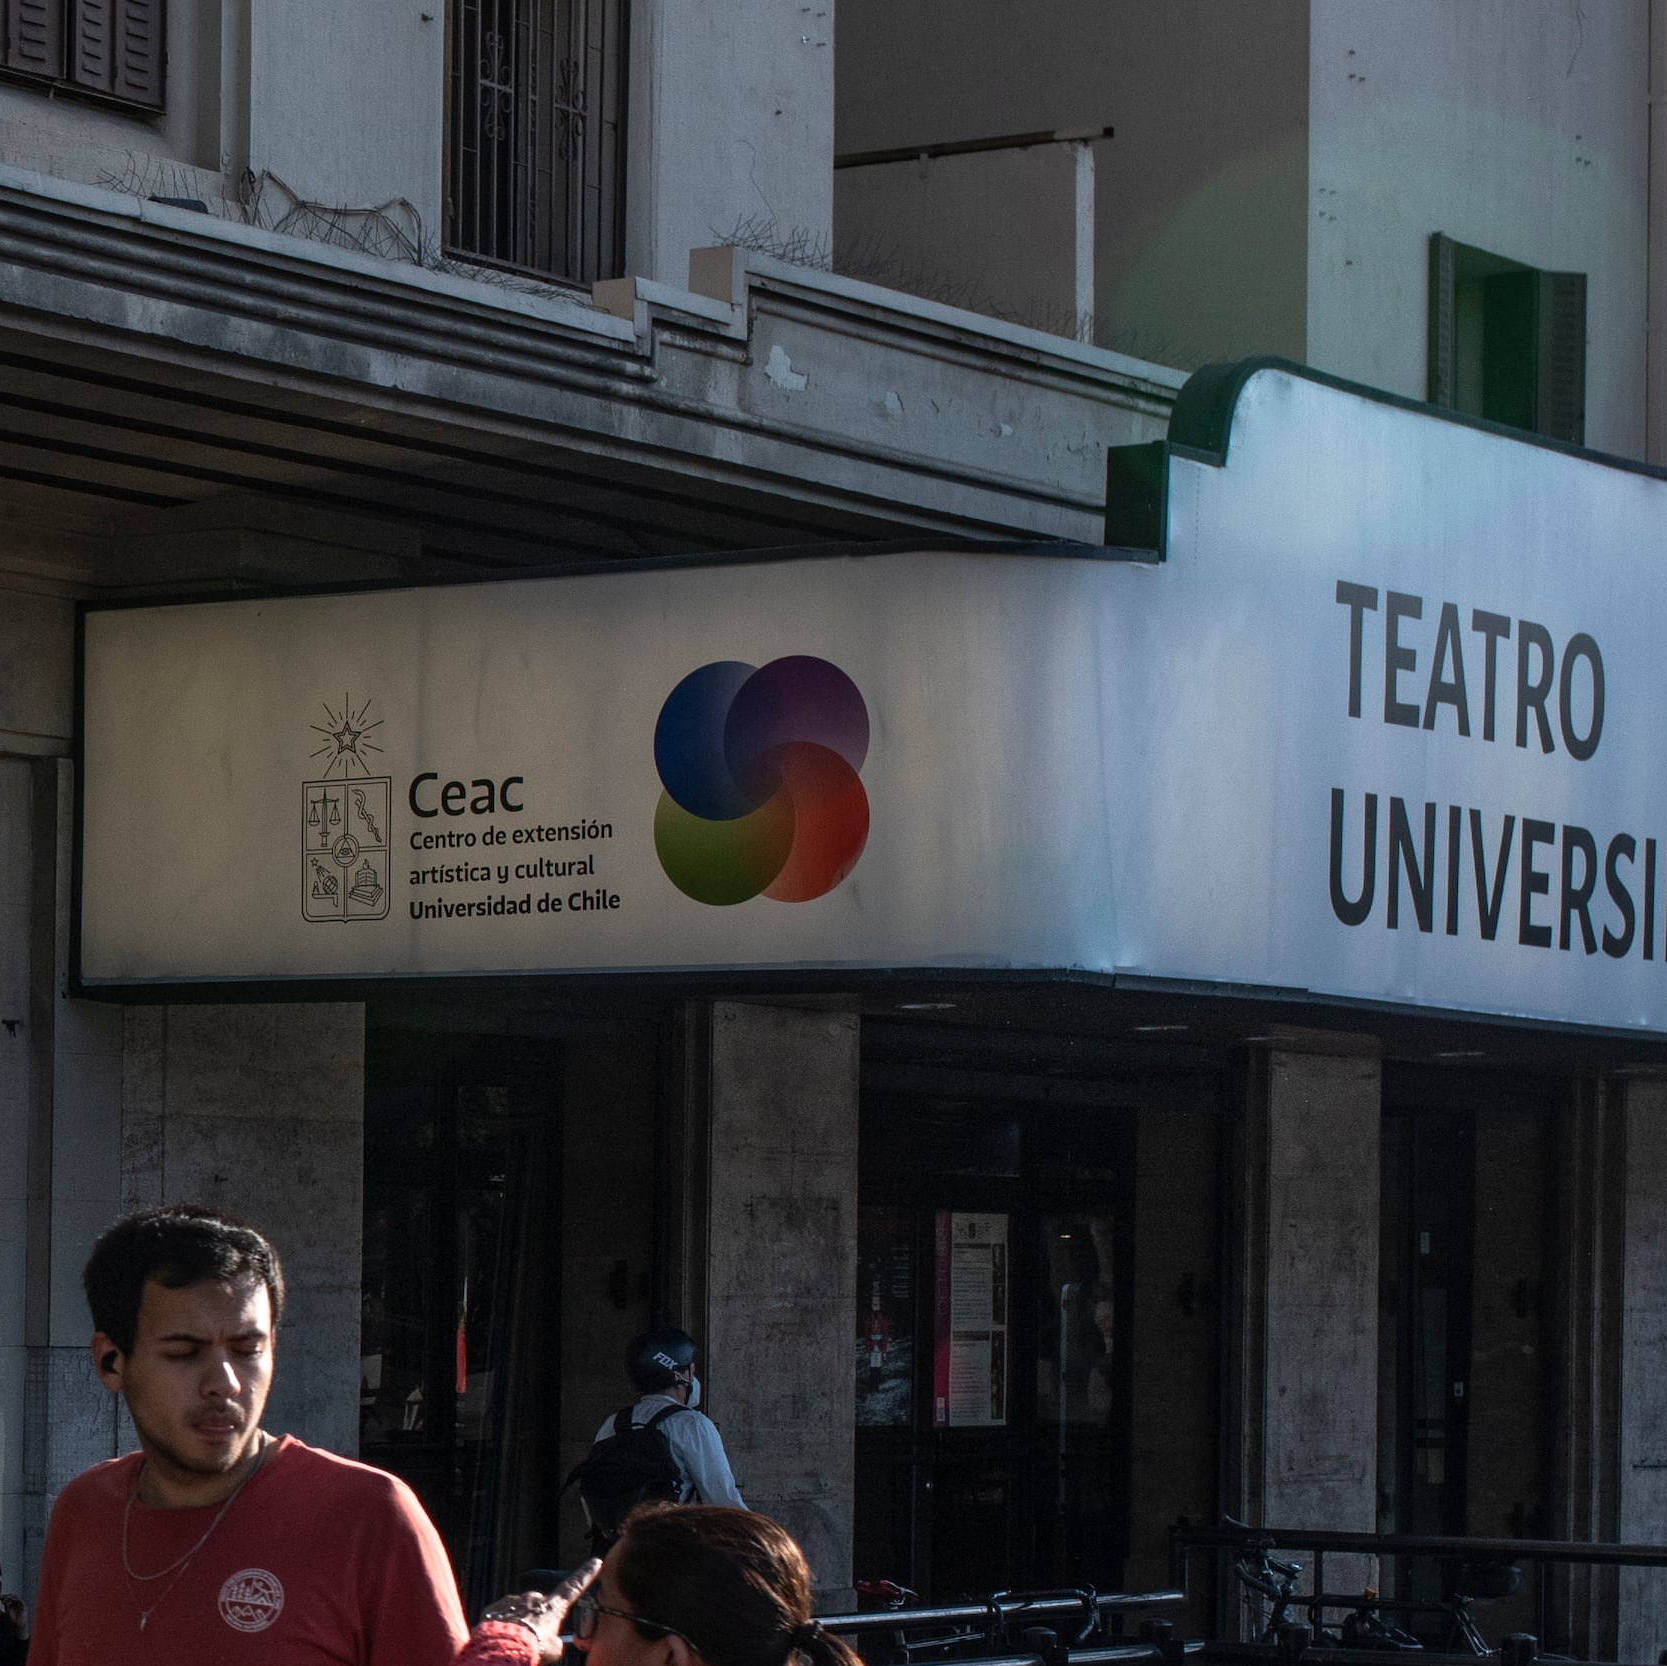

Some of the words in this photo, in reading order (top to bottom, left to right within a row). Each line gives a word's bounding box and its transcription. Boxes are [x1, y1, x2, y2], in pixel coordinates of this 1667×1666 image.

[1336, 579, 1605, 761] TEATRO
[408, 772, 524, 818] Ceac
[410, 829, 476, 851] Centro
[482, 826, 508, 848] de
[512, 820, 613, 845] extensión
[409, 863, 491, 885] artística
[497, 866, 509, 885] y
[515, 855, 595, 879] cultural
[1329, 787, 1667, 961] UNIVERSI
[409, 896, 532, 920] Universidad
[536, 893, 563, 914] de
[568, 890, 620, 912] Chile
[653, 1352, 678, 1371] FOX
